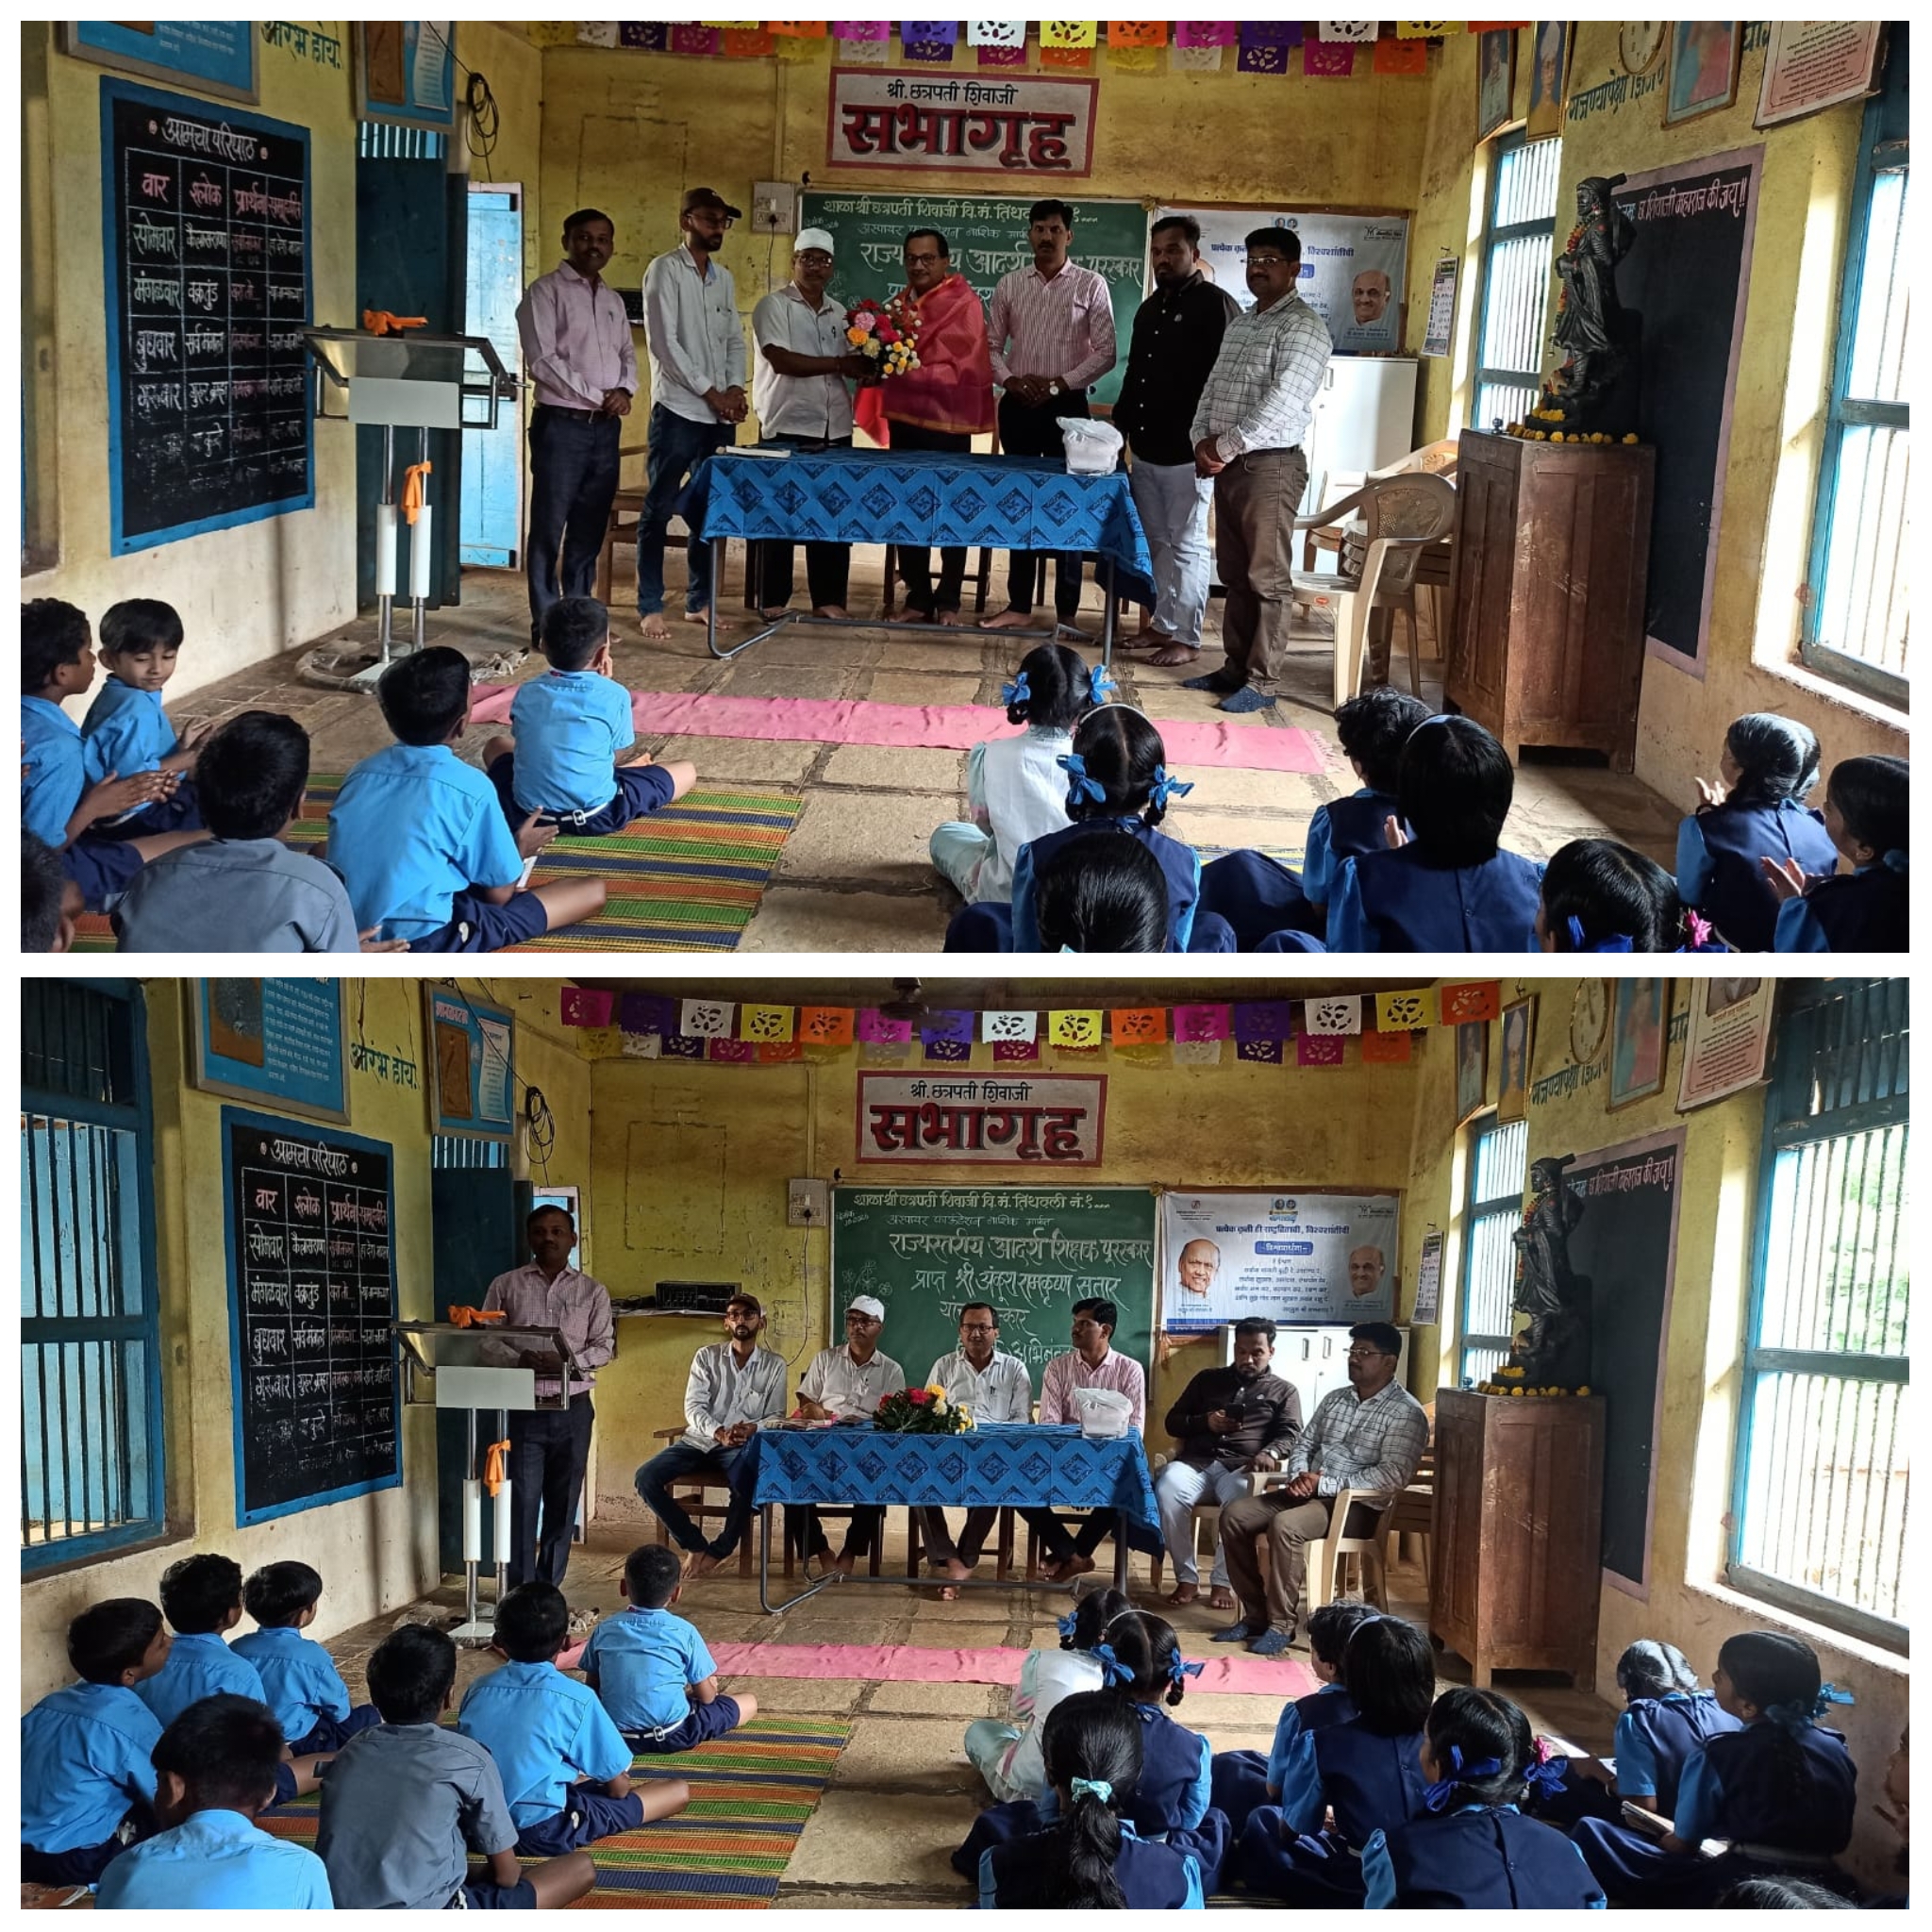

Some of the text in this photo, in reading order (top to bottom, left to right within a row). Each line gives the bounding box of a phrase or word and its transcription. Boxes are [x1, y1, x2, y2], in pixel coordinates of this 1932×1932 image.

[909, 80, 960, 101] छत्रपती
[963, 81, 1019, 106] शिवाजी
[841, 103, 1076, 169] सभागृह
[142, 173, 170, 202] वार
[1675, 189, 1707, 217] महाराज
[916, 199, 958, 218] शिवाजी
[133, 212, 177, 258] सोमवार
[134, 271, 183, 310] मंगळवार
[135, 330, 177, 373] बुधवार
[350, 1040, 391, 1081] आरंभ
[932, 1080, 979, 1100] छत्रपती
[982, 1080, 1033, 1103] शिवाजी
[870, 1102, 1087, 1160] सभागृह
[256, 1189, 278, 1214] वार
[941, 1191, 980, 1208] शिवाजी
[249, 1224, 286, 1264] सोमवार
[889, 1228, 985, 1264] राज्यस्तरीय
[988, 1227, 1051, 1266] आदर्श
[1051, 1227, 1099, 1273] शिक्षक
[251, 1274, 289, 1309] मंगळवार
[910, 1270, 947, 1295] प्राप्त
[956, 1262, 976, 1299] श्री
[252, 1327, 288, 1365] बुधवार
